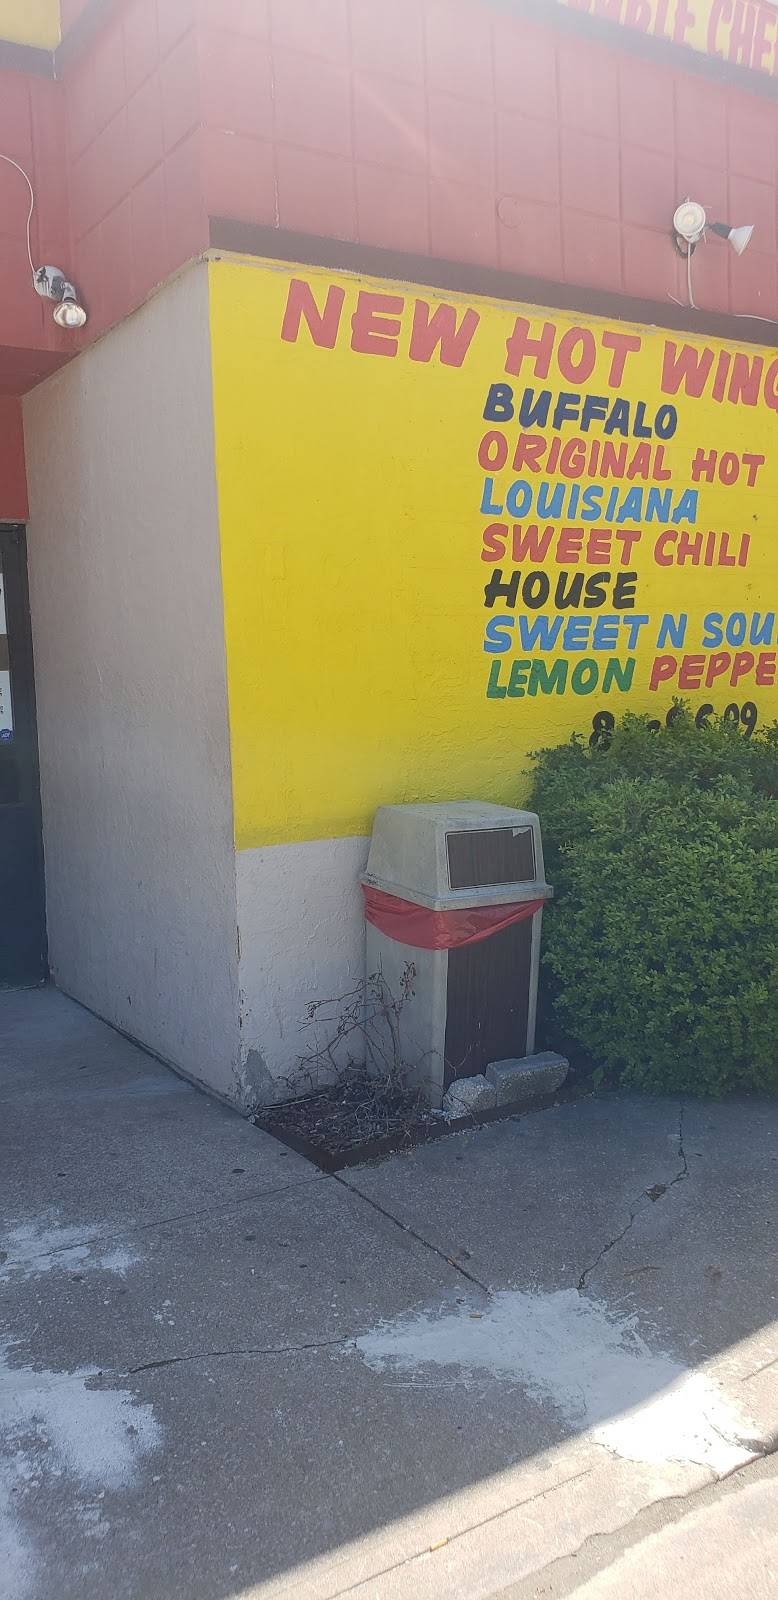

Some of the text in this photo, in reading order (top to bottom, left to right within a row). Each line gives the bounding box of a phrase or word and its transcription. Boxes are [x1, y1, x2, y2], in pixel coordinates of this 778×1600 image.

[280, 278, 480, 368] NEW
[504, 317, 641, 388] HOT
[483, 383, 678, 440] BUFFALO
[478, 431, 765, 487] ORIGINAL HOT
[480, 477, 699, 524] LOUISIANA
[481, 523, 751, 567] SWEET CHILI
[484, 569, 638, 609] HOUSE
[483, 612, 778, 653] SWEET N SOU
[486, 658, 636, 699] LEMON
